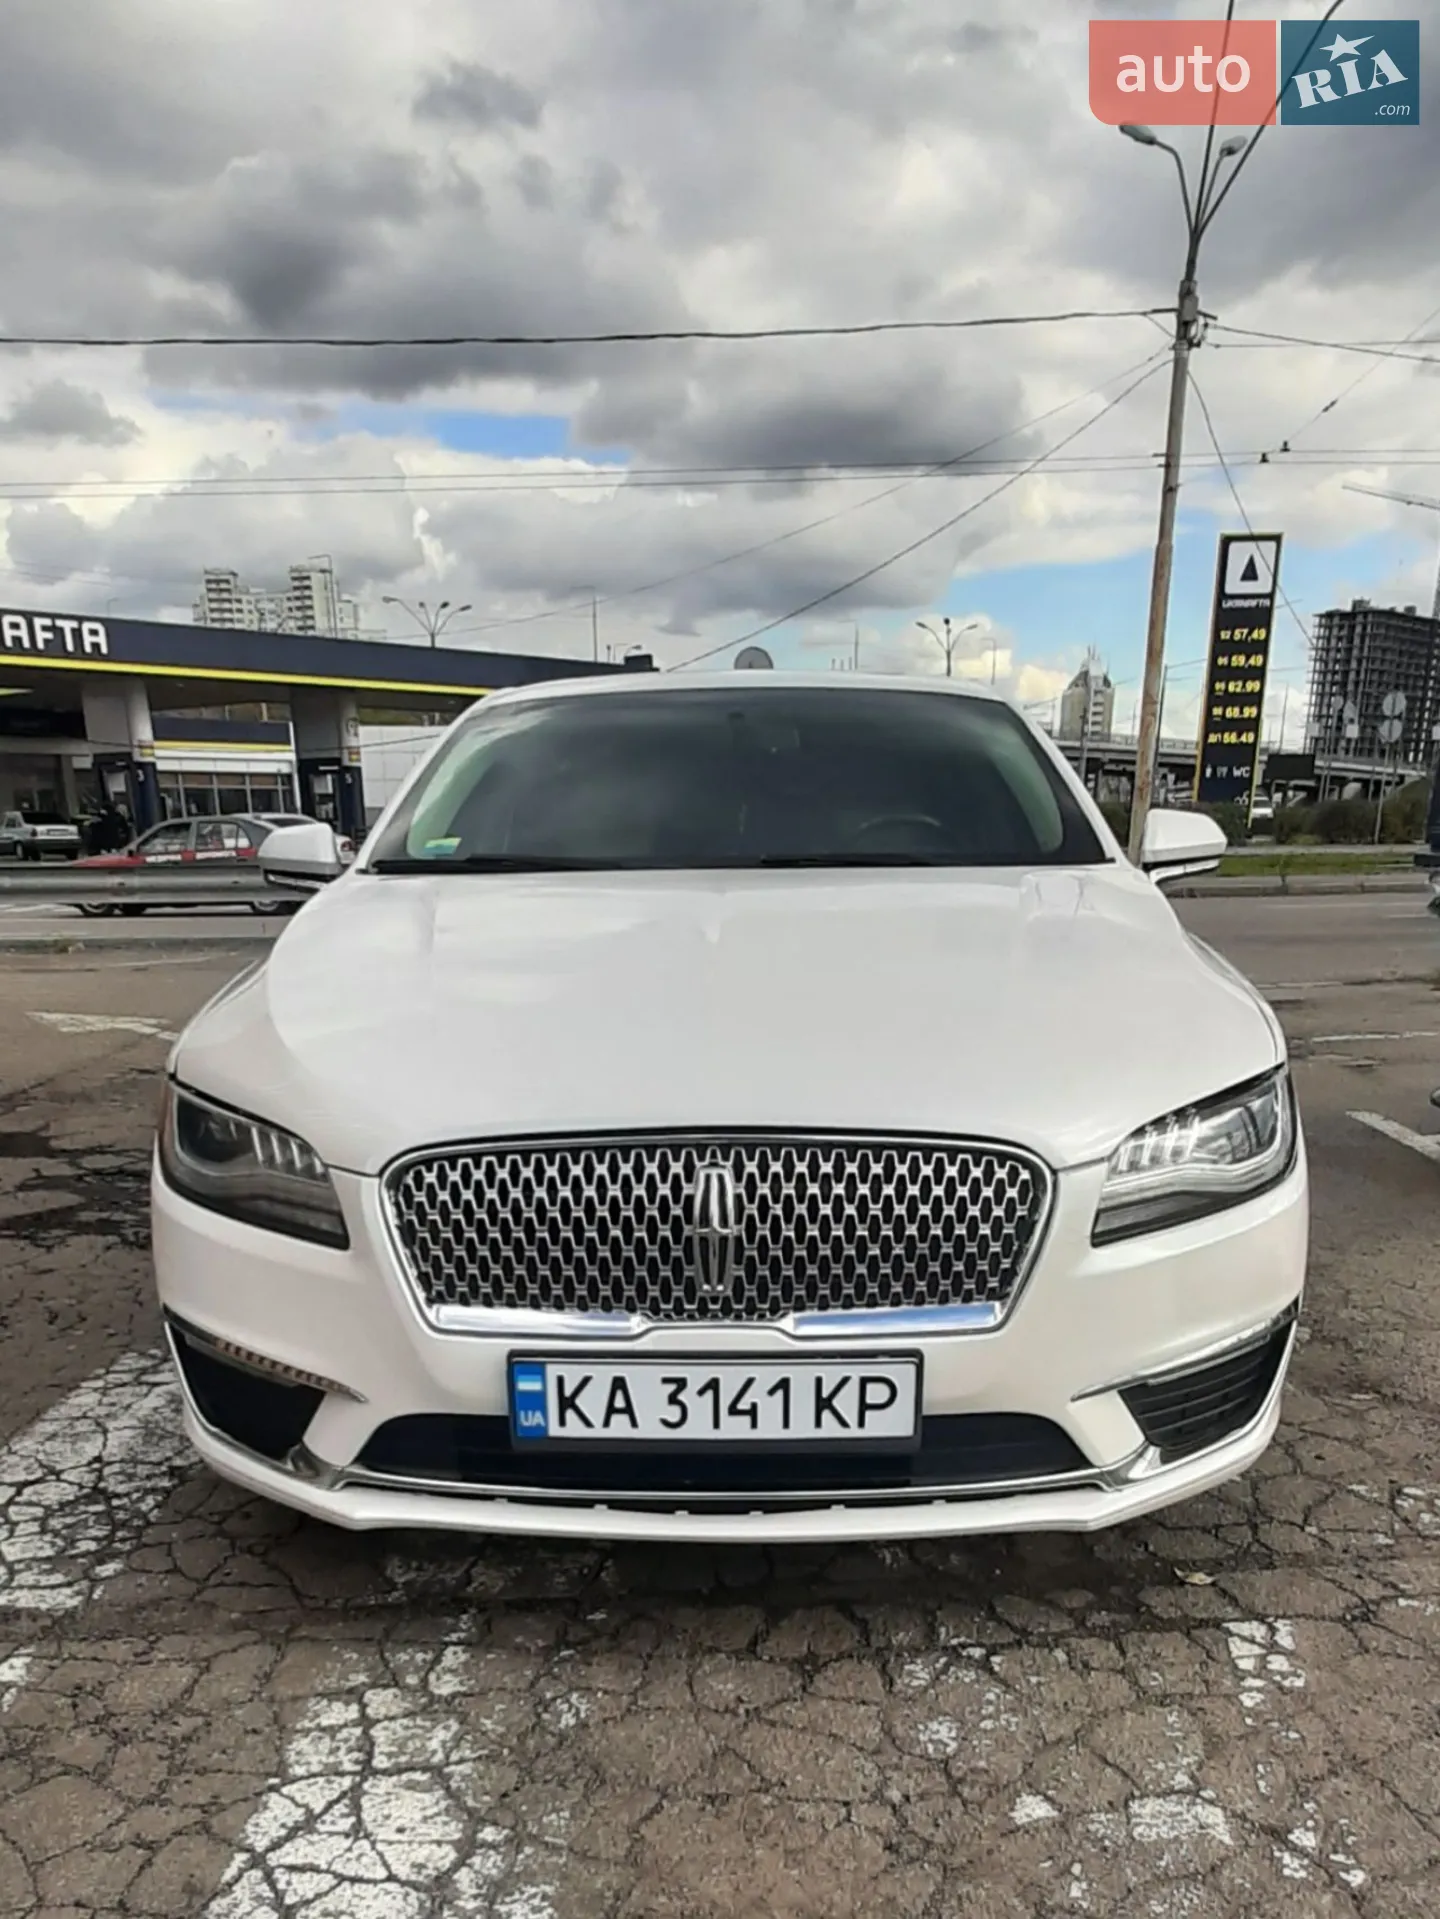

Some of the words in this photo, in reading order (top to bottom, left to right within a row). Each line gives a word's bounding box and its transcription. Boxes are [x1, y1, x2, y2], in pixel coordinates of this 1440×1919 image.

[2, 614, 108, 655] AFTA
[1233, 766, 1250, 778] WC
[556, 1375, 639, 1428] KA
[658, 1377, 791, 1429] 3141
[813, 1375, 898, 1428] KP
[520, 1410, 546, 1427] UA
